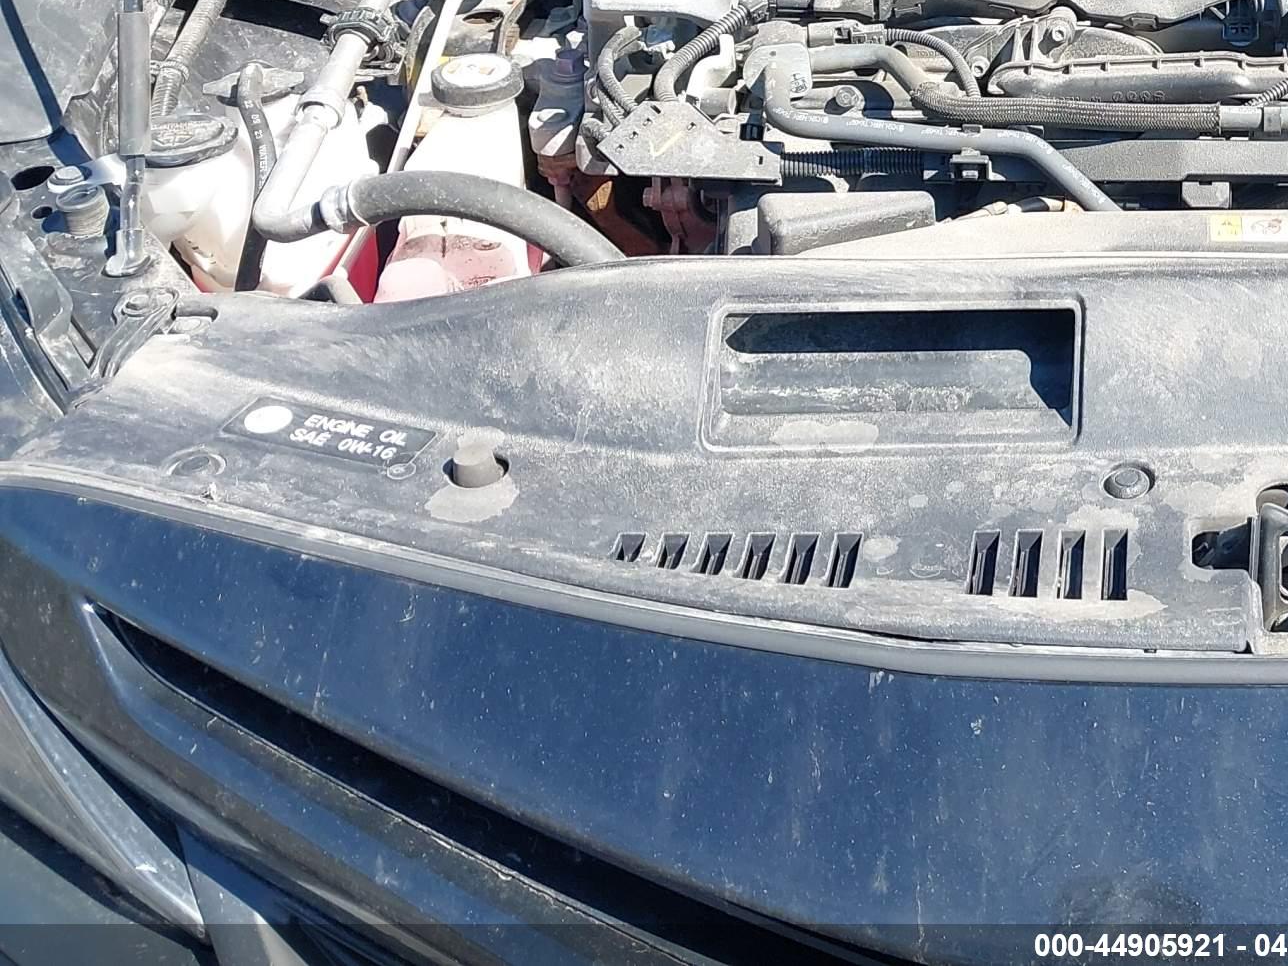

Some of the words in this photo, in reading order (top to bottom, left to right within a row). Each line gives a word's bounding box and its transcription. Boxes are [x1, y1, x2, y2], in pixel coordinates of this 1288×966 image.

[259, 144, 268, 172] WATER
[289, 428, 331, 447] SAE
[337, 438, 398, 459] 0W-16
[303, 414, 374, 438] ENGINE
[378, 429, 409, 446] OIL
